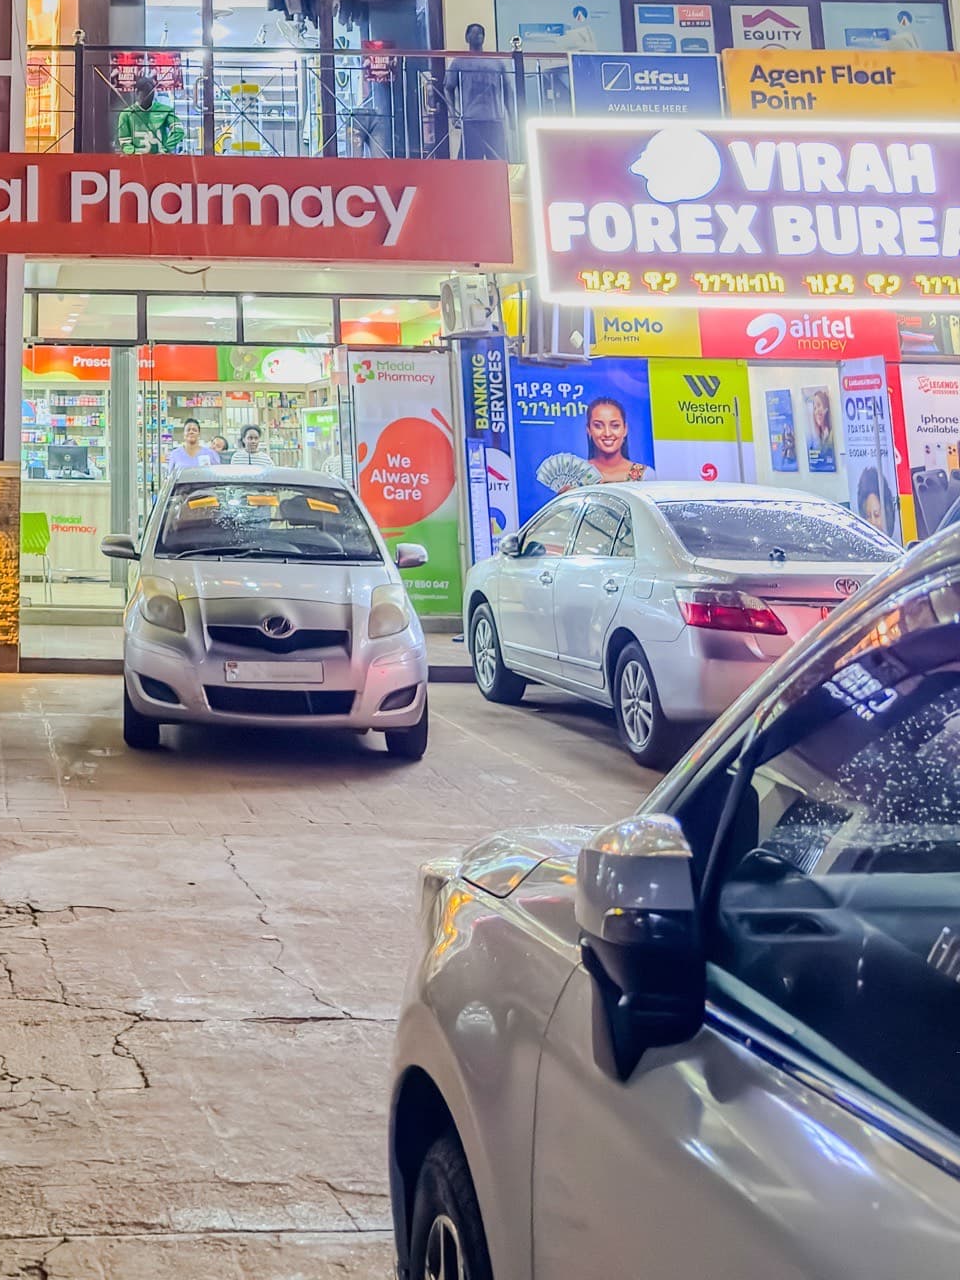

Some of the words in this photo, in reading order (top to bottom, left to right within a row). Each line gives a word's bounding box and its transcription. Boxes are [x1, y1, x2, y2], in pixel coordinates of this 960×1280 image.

[744, 29, 802, 41] EQUITY
[634, 70, 689, 85] dfcu
[750, 64, 827, 89] Agent
[831, 65, 896, 86] Float
[608, 103, 660, 113] AVAILABLE
[662, 104, 689, 113] HERE
[751, 90, 817, 111] Point
[728, 140, 937, 194] VIRAH
[69, 168, 417, 248] Pharmacy
[547, 201, 762, 255] FOREX
[915, 274, 960, 295] ንገን
[603, 317, 664, 333] MoMo
[790, 314, 855, 340] airtel
[603, 334, 622, 343] from
[624, 335, 640, 343] MTN
[797, 338, 848, 353] money
[73, 355, 155, 368] Prescns
[376, 360, 415, 371] Medal
[377, 371, 436, 385] Pharmacy
[929, 380, 959, 389] LEGENDS
[472, 353, 490, 430] BANKING
[488, 350, 506, 433] SERVICES
[678, 401, 731, 414] Western
[845, 395, 884, 421] OPEN
[686, 413, 724, 425] Union
[921, 414, 959, 425] Iphone
[916, 425, 959, 434] Available
[387, 452, 411, 468] We
[370, 469, 430, 486] Always
[383, 485, 422, 501] Care
[51, 523, 97, 535] Pharmacy
